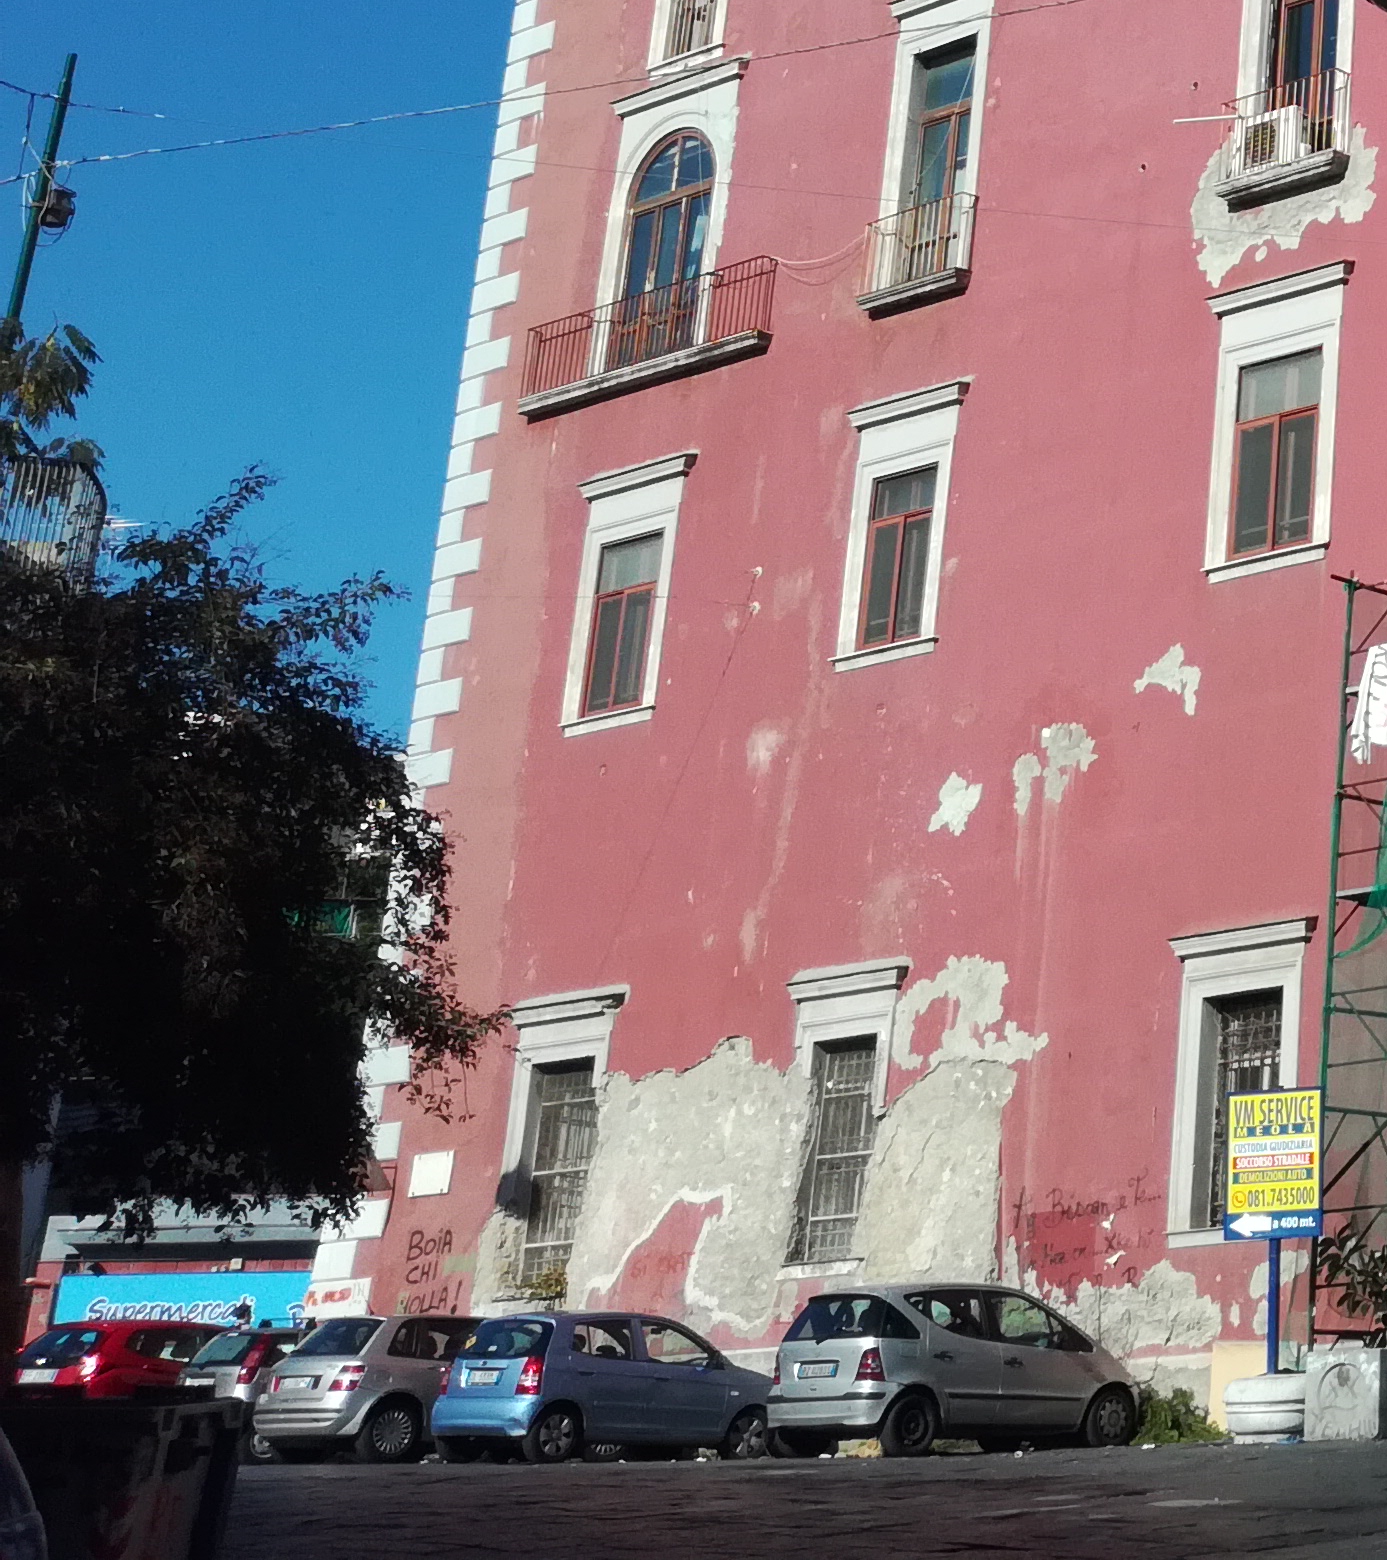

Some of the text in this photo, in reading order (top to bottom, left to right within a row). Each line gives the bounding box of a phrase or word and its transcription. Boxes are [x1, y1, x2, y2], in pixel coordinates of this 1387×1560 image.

[1234, 1096, 1315, 1127] VM SERVICE
[1236, 1124, 1313, 1138] MEOLA
[1234, 1142, 1267, 1155] CUSTODIA
[1236, 1154, 1310, 1169] SOCCORSO STRADALE
[1239, 1169, 1307, 1184] DEMOLIZIONI AUTO
[1247, 1186, 1315, 1208] 081.7435000
[1281, 1217, 1299, 1228] 400
[1300, 1216, 1316, 1227] mt.
[406, 1260, 438, 1285] CHI
[86, 1295, 256, 1323] Supermerca
